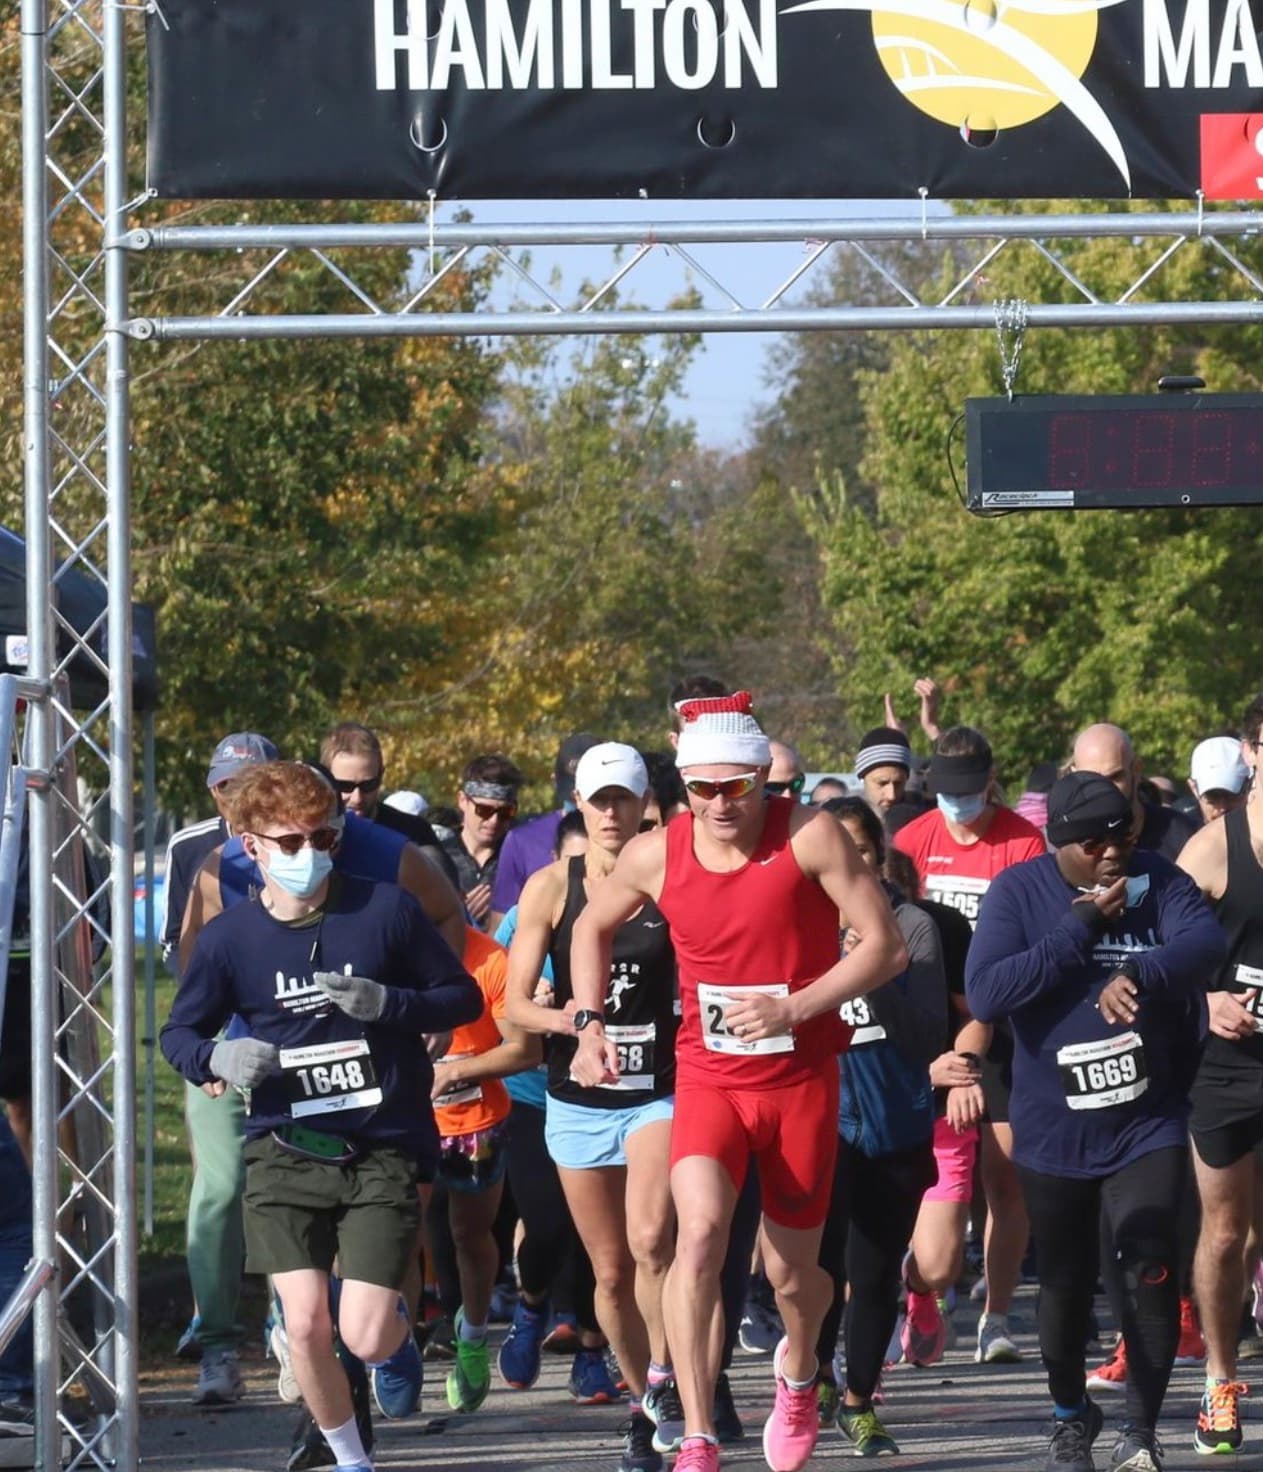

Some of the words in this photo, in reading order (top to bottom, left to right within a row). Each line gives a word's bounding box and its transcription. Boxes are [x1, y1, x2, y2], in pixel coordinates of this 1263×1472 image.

[374, 0, 778, 90] HAMILTON
[840, 998, 870, 1025] 43
[297, 1060, 365, 1096] 1648
[1072, 1054, 1137, 1092] 1669
